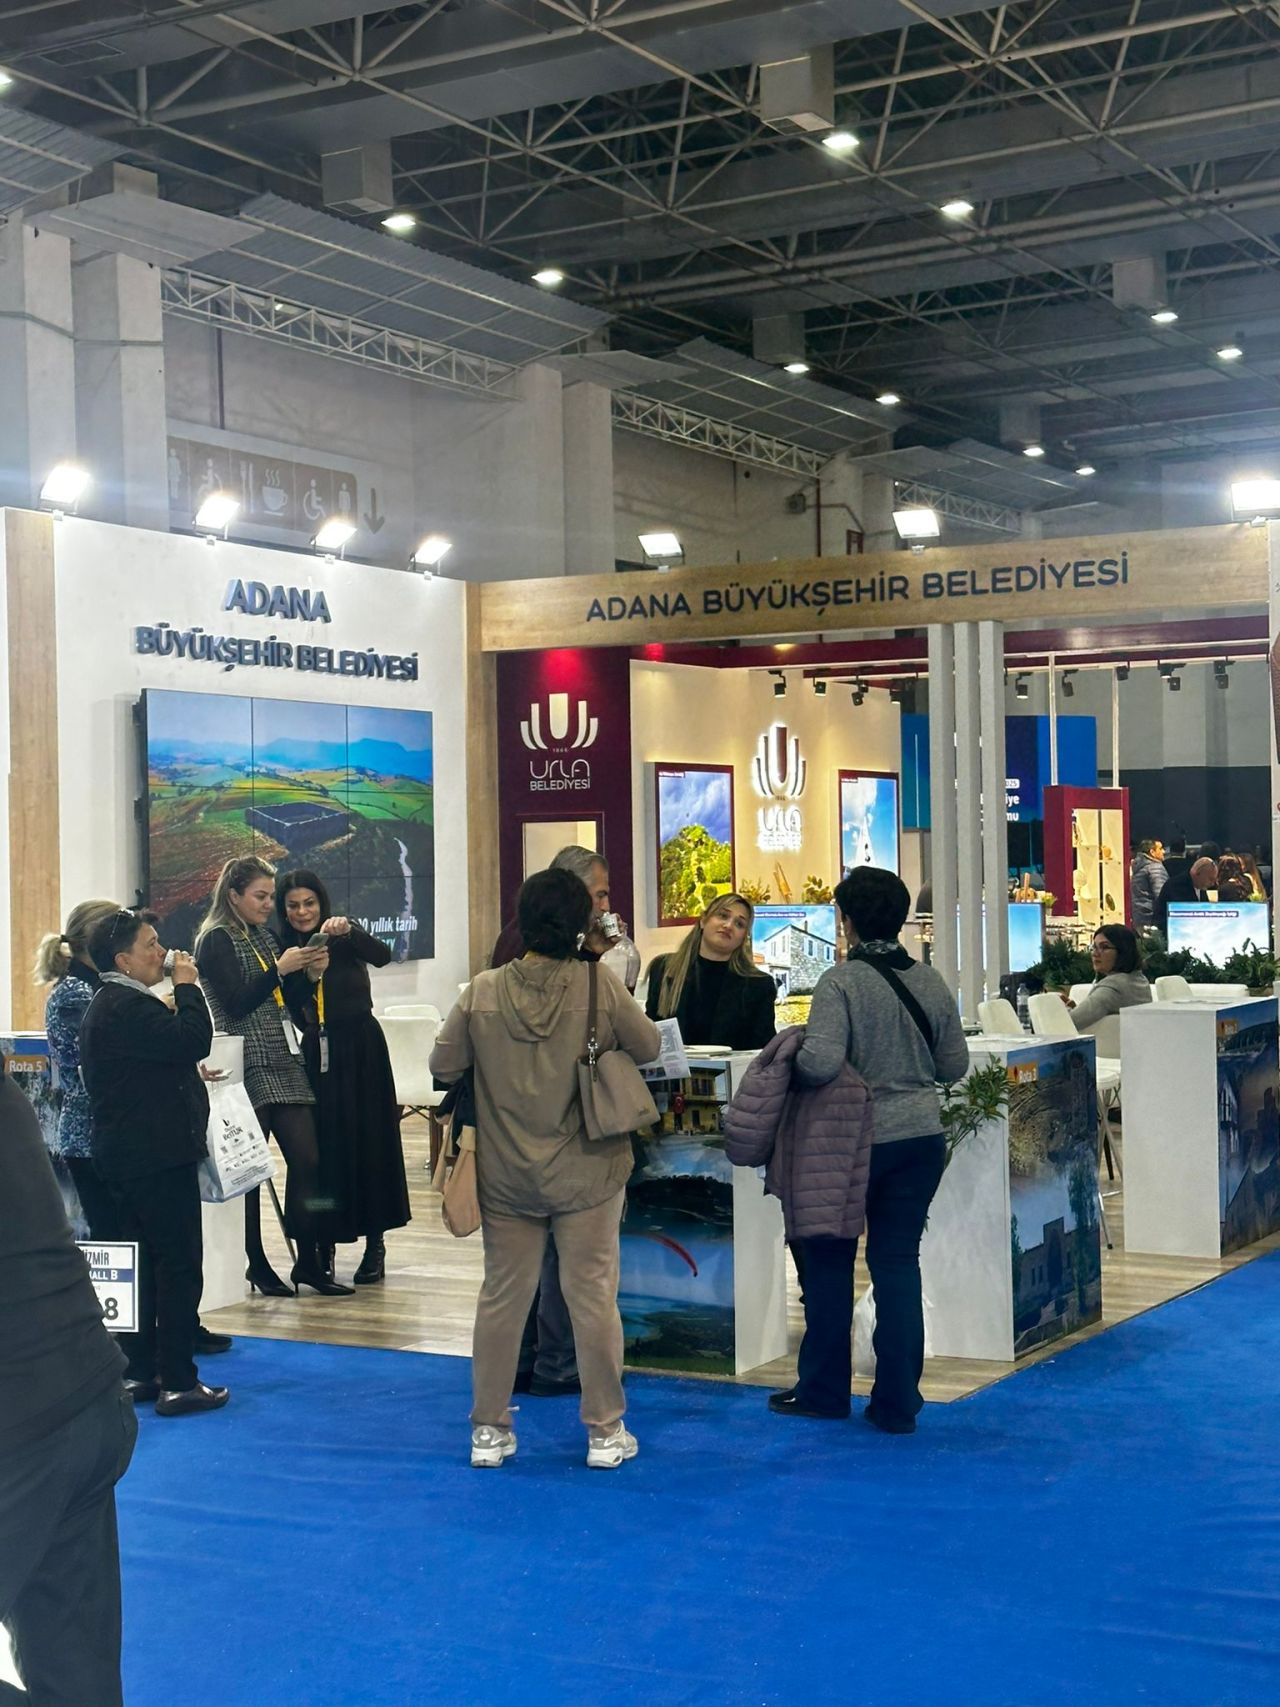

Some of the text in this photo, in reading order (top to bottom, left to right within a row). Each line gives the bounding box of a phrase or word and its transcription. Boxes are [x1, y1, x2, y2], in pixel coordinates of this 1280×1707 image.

[587, 551, 1128, 622] ADANA BÜYÜKŞEHİR BELEDİYESİ
[223, 578, 332, 623] ADANA
[134, 622, 419, 681] BÜYÜKŞEHİR BELEDİYESİ
[529, 778, 591, 791] BELEDİYESİ
[370, 917, 393, 936] yıllık
[396, 916, 418, 931] tarih
[9, 1060, 43, 1073] Rota 5
[110, 1269, 118, 1280] B
